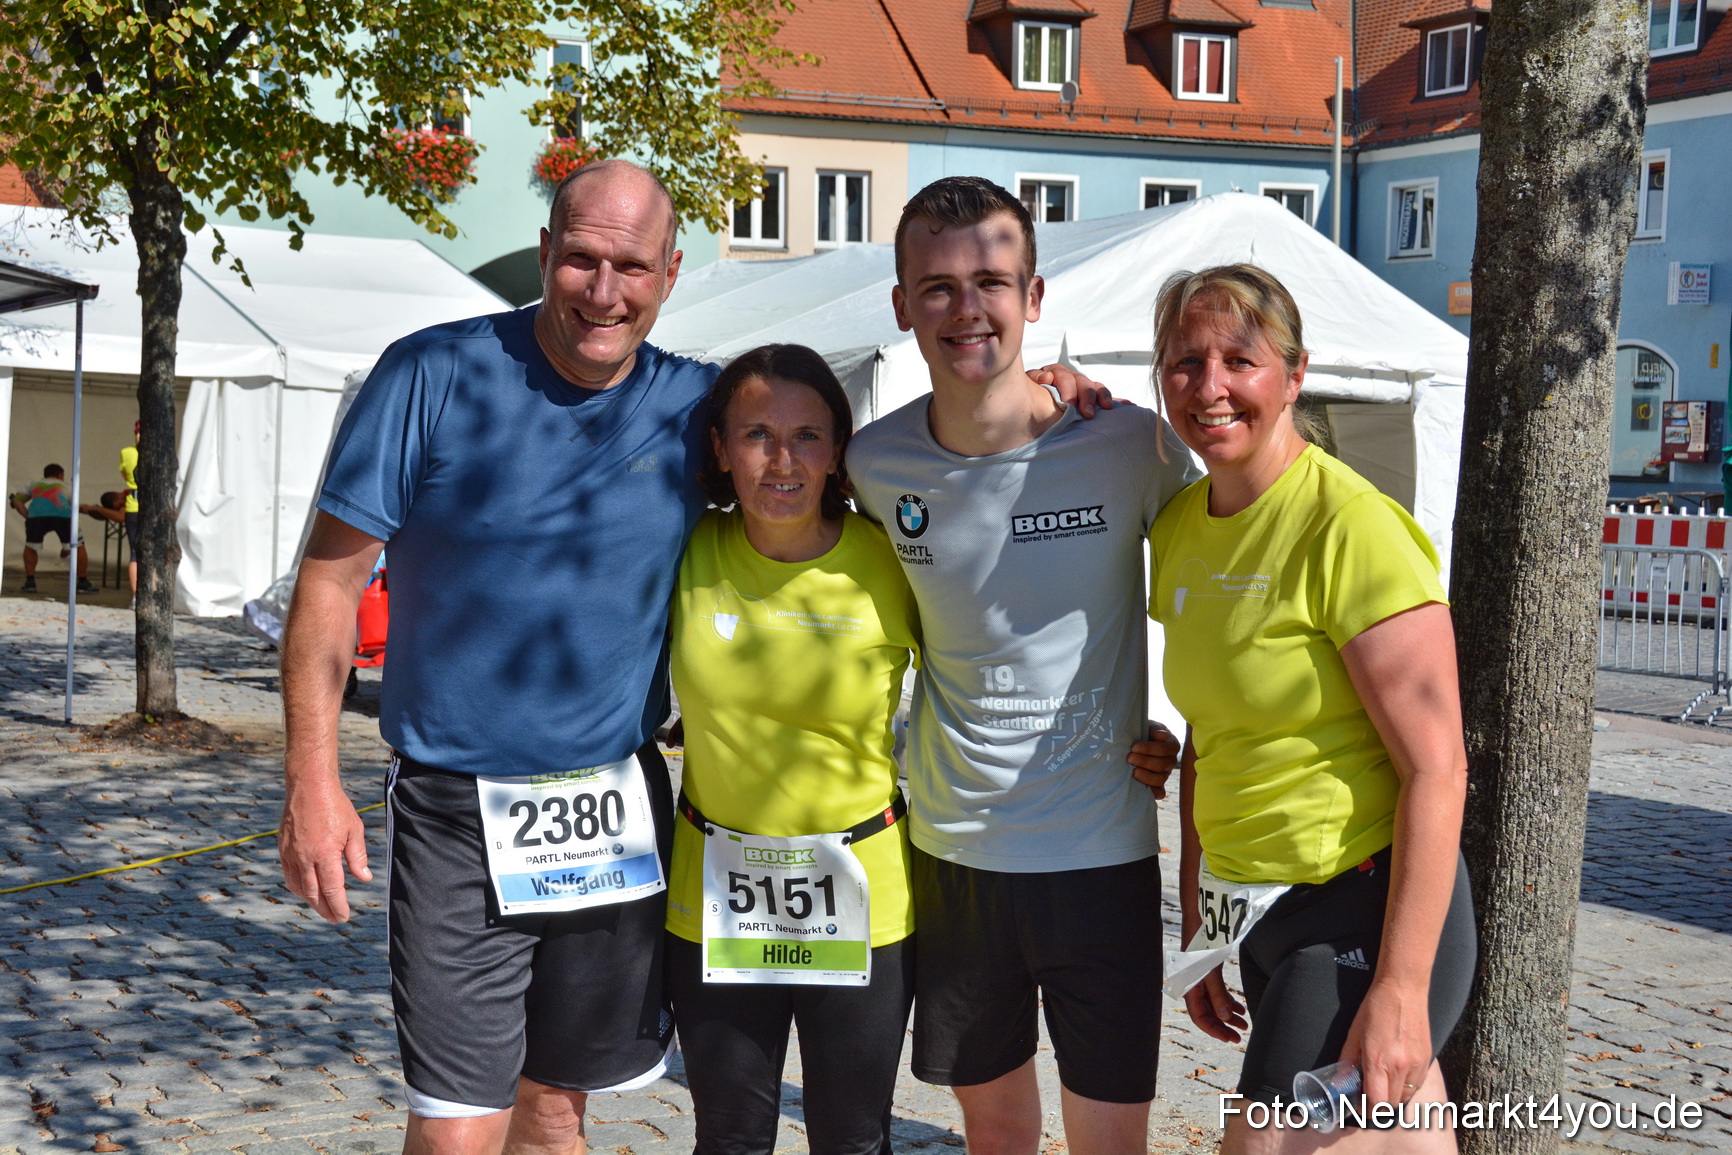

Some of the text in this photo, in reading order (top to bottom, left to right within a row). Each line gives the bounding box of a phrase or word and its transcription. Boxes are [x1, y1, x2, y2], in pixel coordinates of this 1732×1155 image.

[897, 495, 926, 510] BMW
[1011, 505, 1106, 536] BOCK
[1012, 526, 1108, 544] inspired by smart concepts
[896, 542, 933, 557] PARTL
[776, 610, 806, 618] Kliniken
[797, 620, 835, 629] Neumarkt
[979, 665, 1026, 693] 19.
[981, 691, 1085, 711] Neumarkter
[982, 712, 1066, 731] Stadtlauf
[1047, 762, 1060, 772] 16.
[1057, 725, 1091, 764] September
[509, 790, 626, 848] 2380
[496, 841, 503, 850] D
[525, 847, 609, 865] PARTL Neumarkt
[743, 846, 817, 865] BOCK
[531, 870, 626, 896] Wolfgang
[728, 871, 836, 920] 5151
[712, 904, 718, 912] S
[738, 922, 822, 935] PARTL Neumarkt
[763, 944, 812, 965] Hilde
[1333, 957, 1370, 971] adidas
